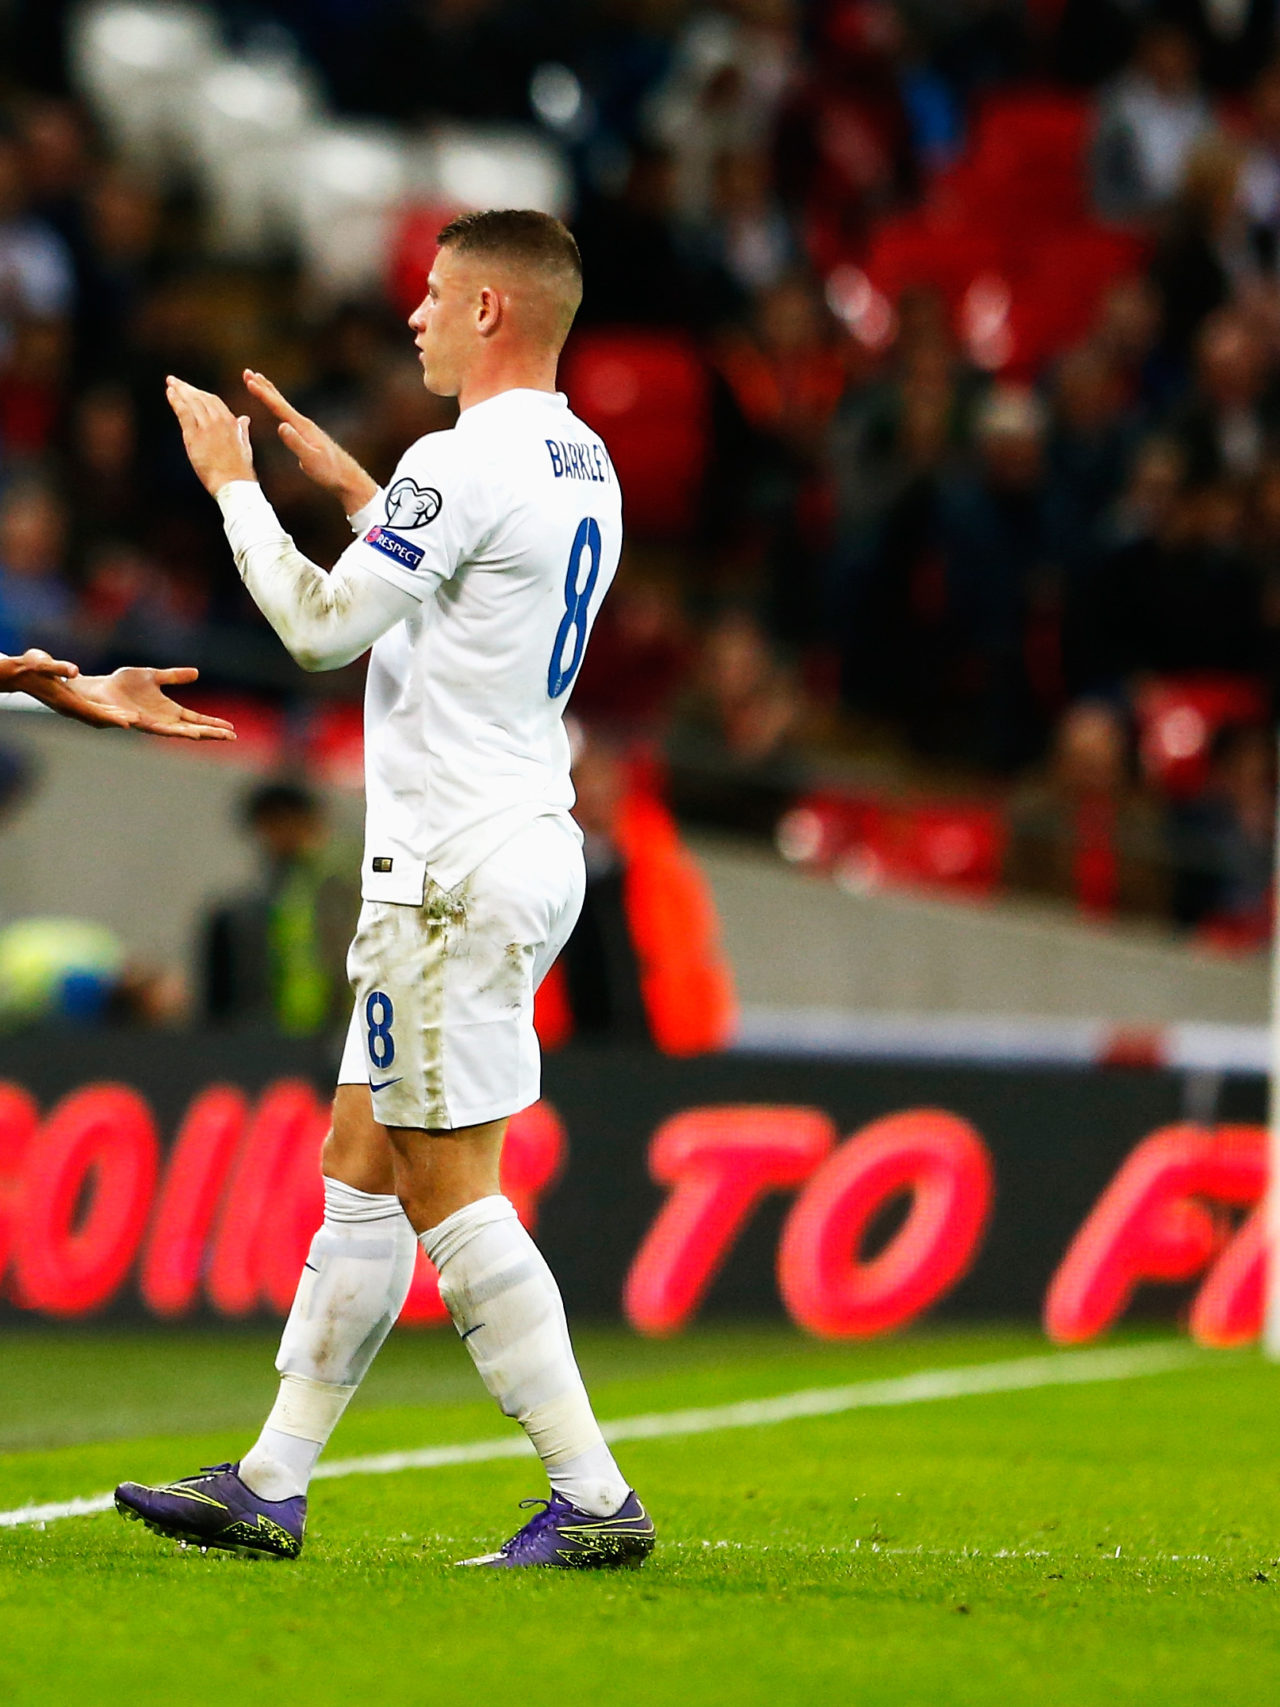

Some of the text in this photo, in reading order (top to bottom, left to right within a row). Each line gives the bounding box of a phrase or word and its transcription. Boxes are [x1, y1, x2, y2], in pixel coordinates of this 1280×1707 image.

[544, 438, 611, 484] BARKLEY
[375, 533, 423, 565] RESPECT
[547, 516, 601, 699] 8
[366, 991, 395, 1069] 8
[624, 1104, 994, 1341] TO
